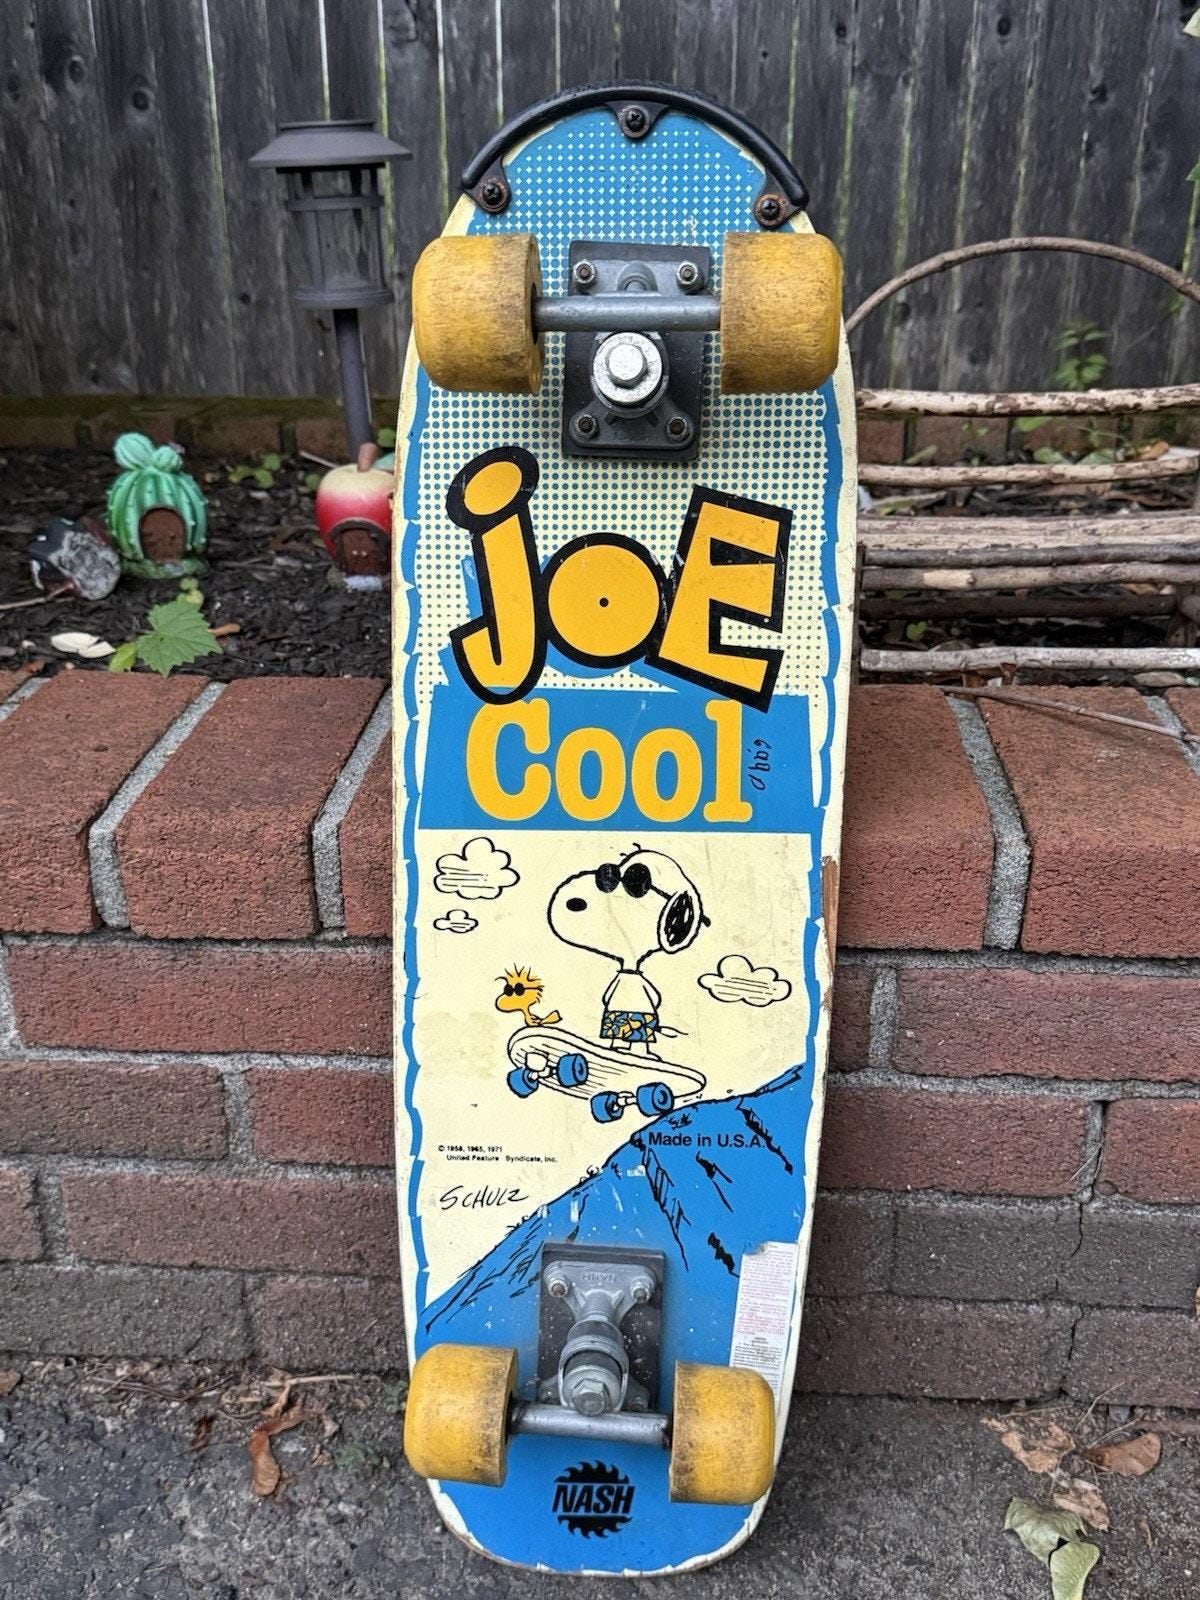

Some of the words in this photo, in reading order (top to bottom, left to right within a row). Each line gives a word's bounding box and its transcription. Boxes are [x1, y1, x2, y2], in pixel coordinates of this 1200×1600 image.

[466, 697, 752, 822] Cool
[648, 1131, 692, 1146] Made
[697, 1132, 711, 1147] in
[505, 1155, 543, 1163] Syndicate,
[439, 1185, 529, 1211] SCHULZ
[552, 1484, 636, 1514] NASH
